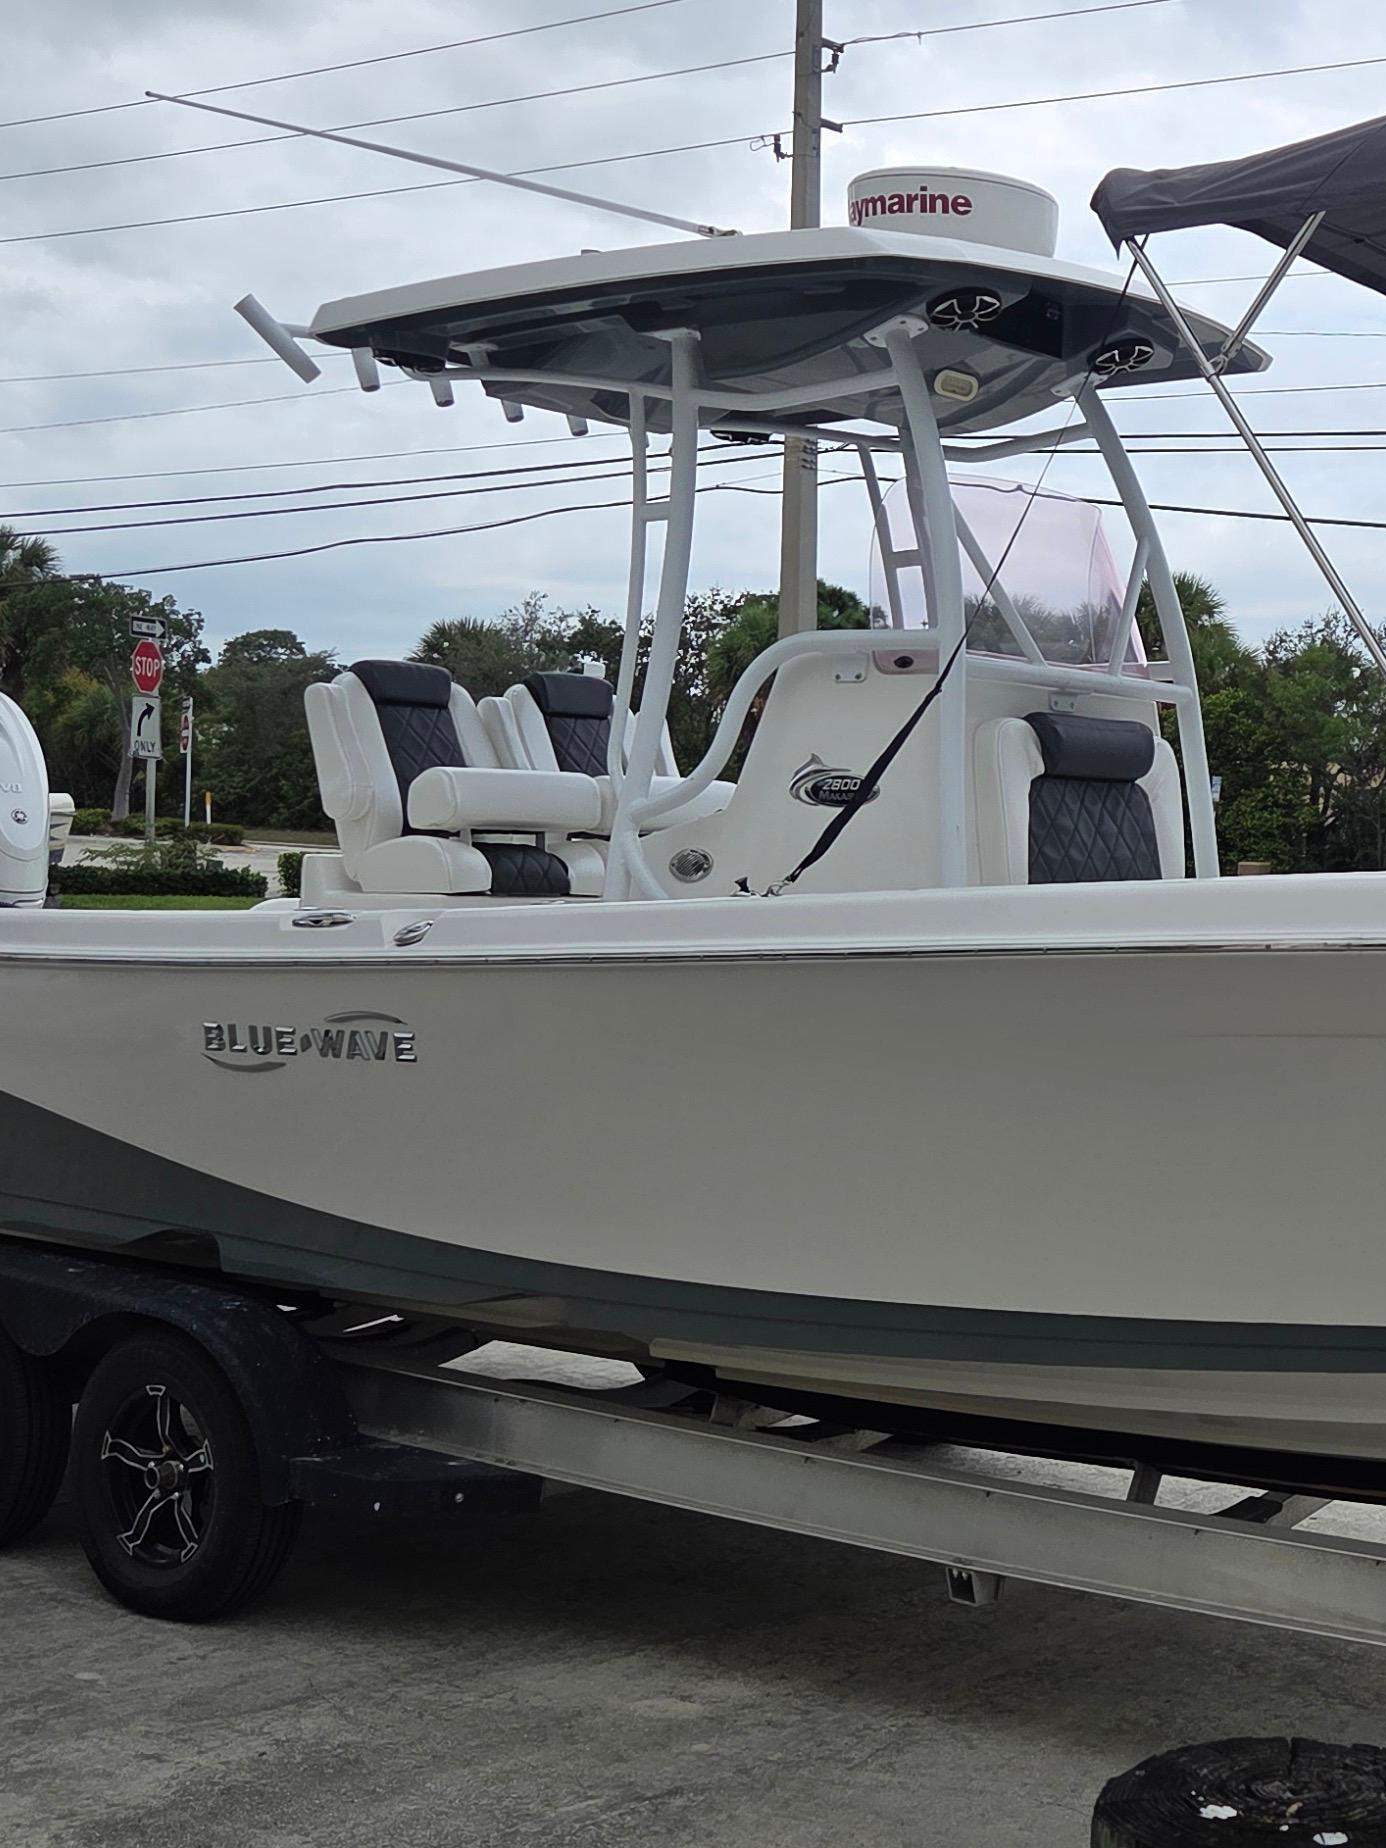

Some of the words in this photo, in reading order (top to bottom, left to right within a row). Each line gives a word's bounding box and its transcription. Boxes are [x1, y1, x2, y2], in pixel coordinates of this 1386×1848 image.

[849, 186, 973, 227] aymarine
[134, 656, 160, 678] STOP
[133, 740, 156, 753] ONLY
[822, 778, 862, 791] 2800
[202, 1022, 298, 1056] BLUE
[309, 1027, 418, 1063] WAVE
